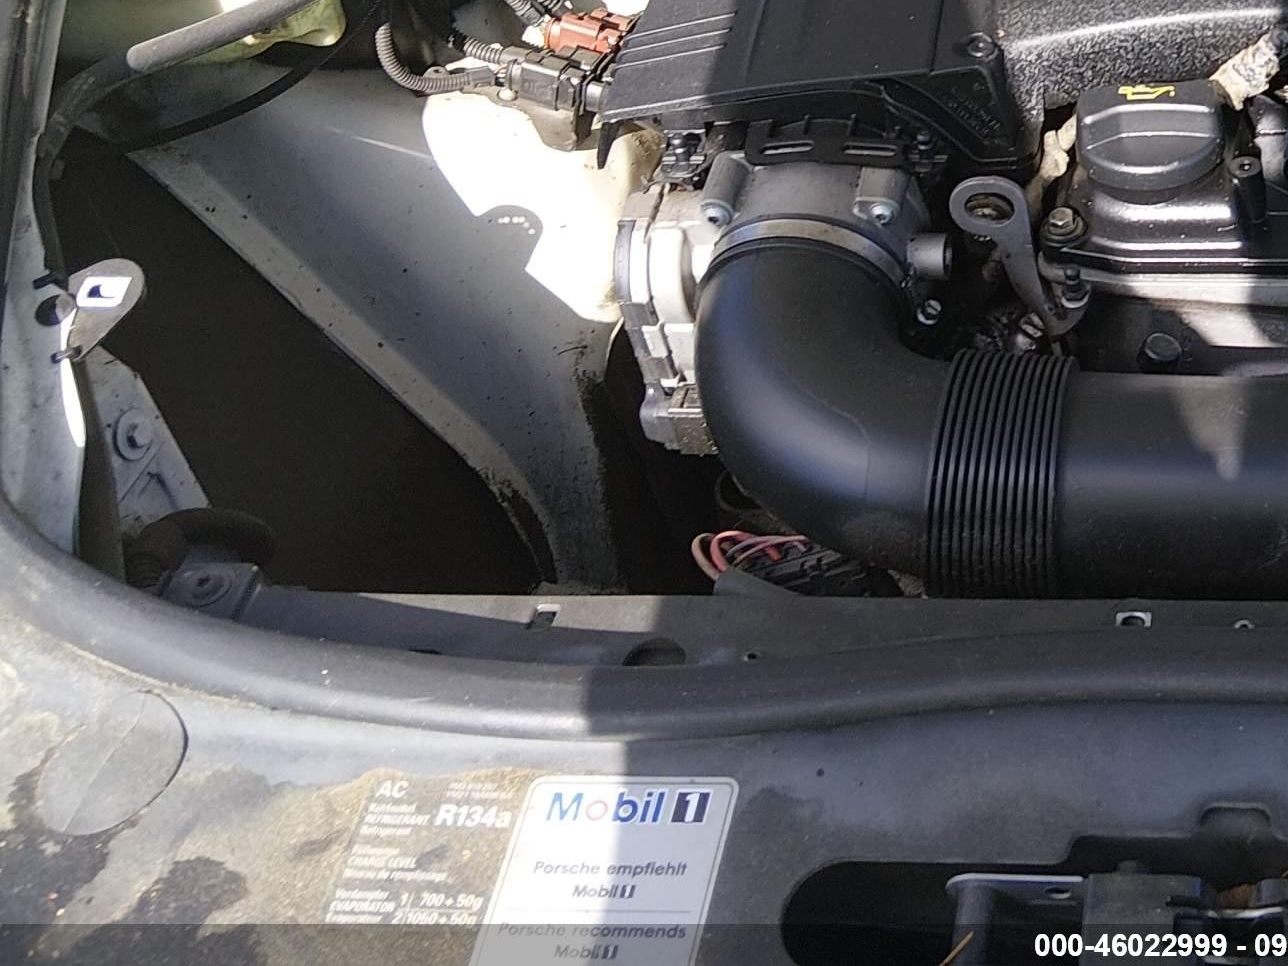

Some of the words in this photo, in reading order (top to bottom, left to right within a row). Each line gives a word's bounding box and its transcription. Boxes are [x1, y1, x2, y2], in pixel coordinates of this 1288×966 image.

[375, 780, 409, 798] AC
[434, 804, 513, 827] R134a
[546, 791, 666, 822] Mobil
[533, 861, 600, 875] Porsche
[606, 861, 687, 878] empfiehlt
[420, 893, 445, 907] 700
[500, 921, 565, 937] Porsche
[571, 923, 687, 939] recommends
